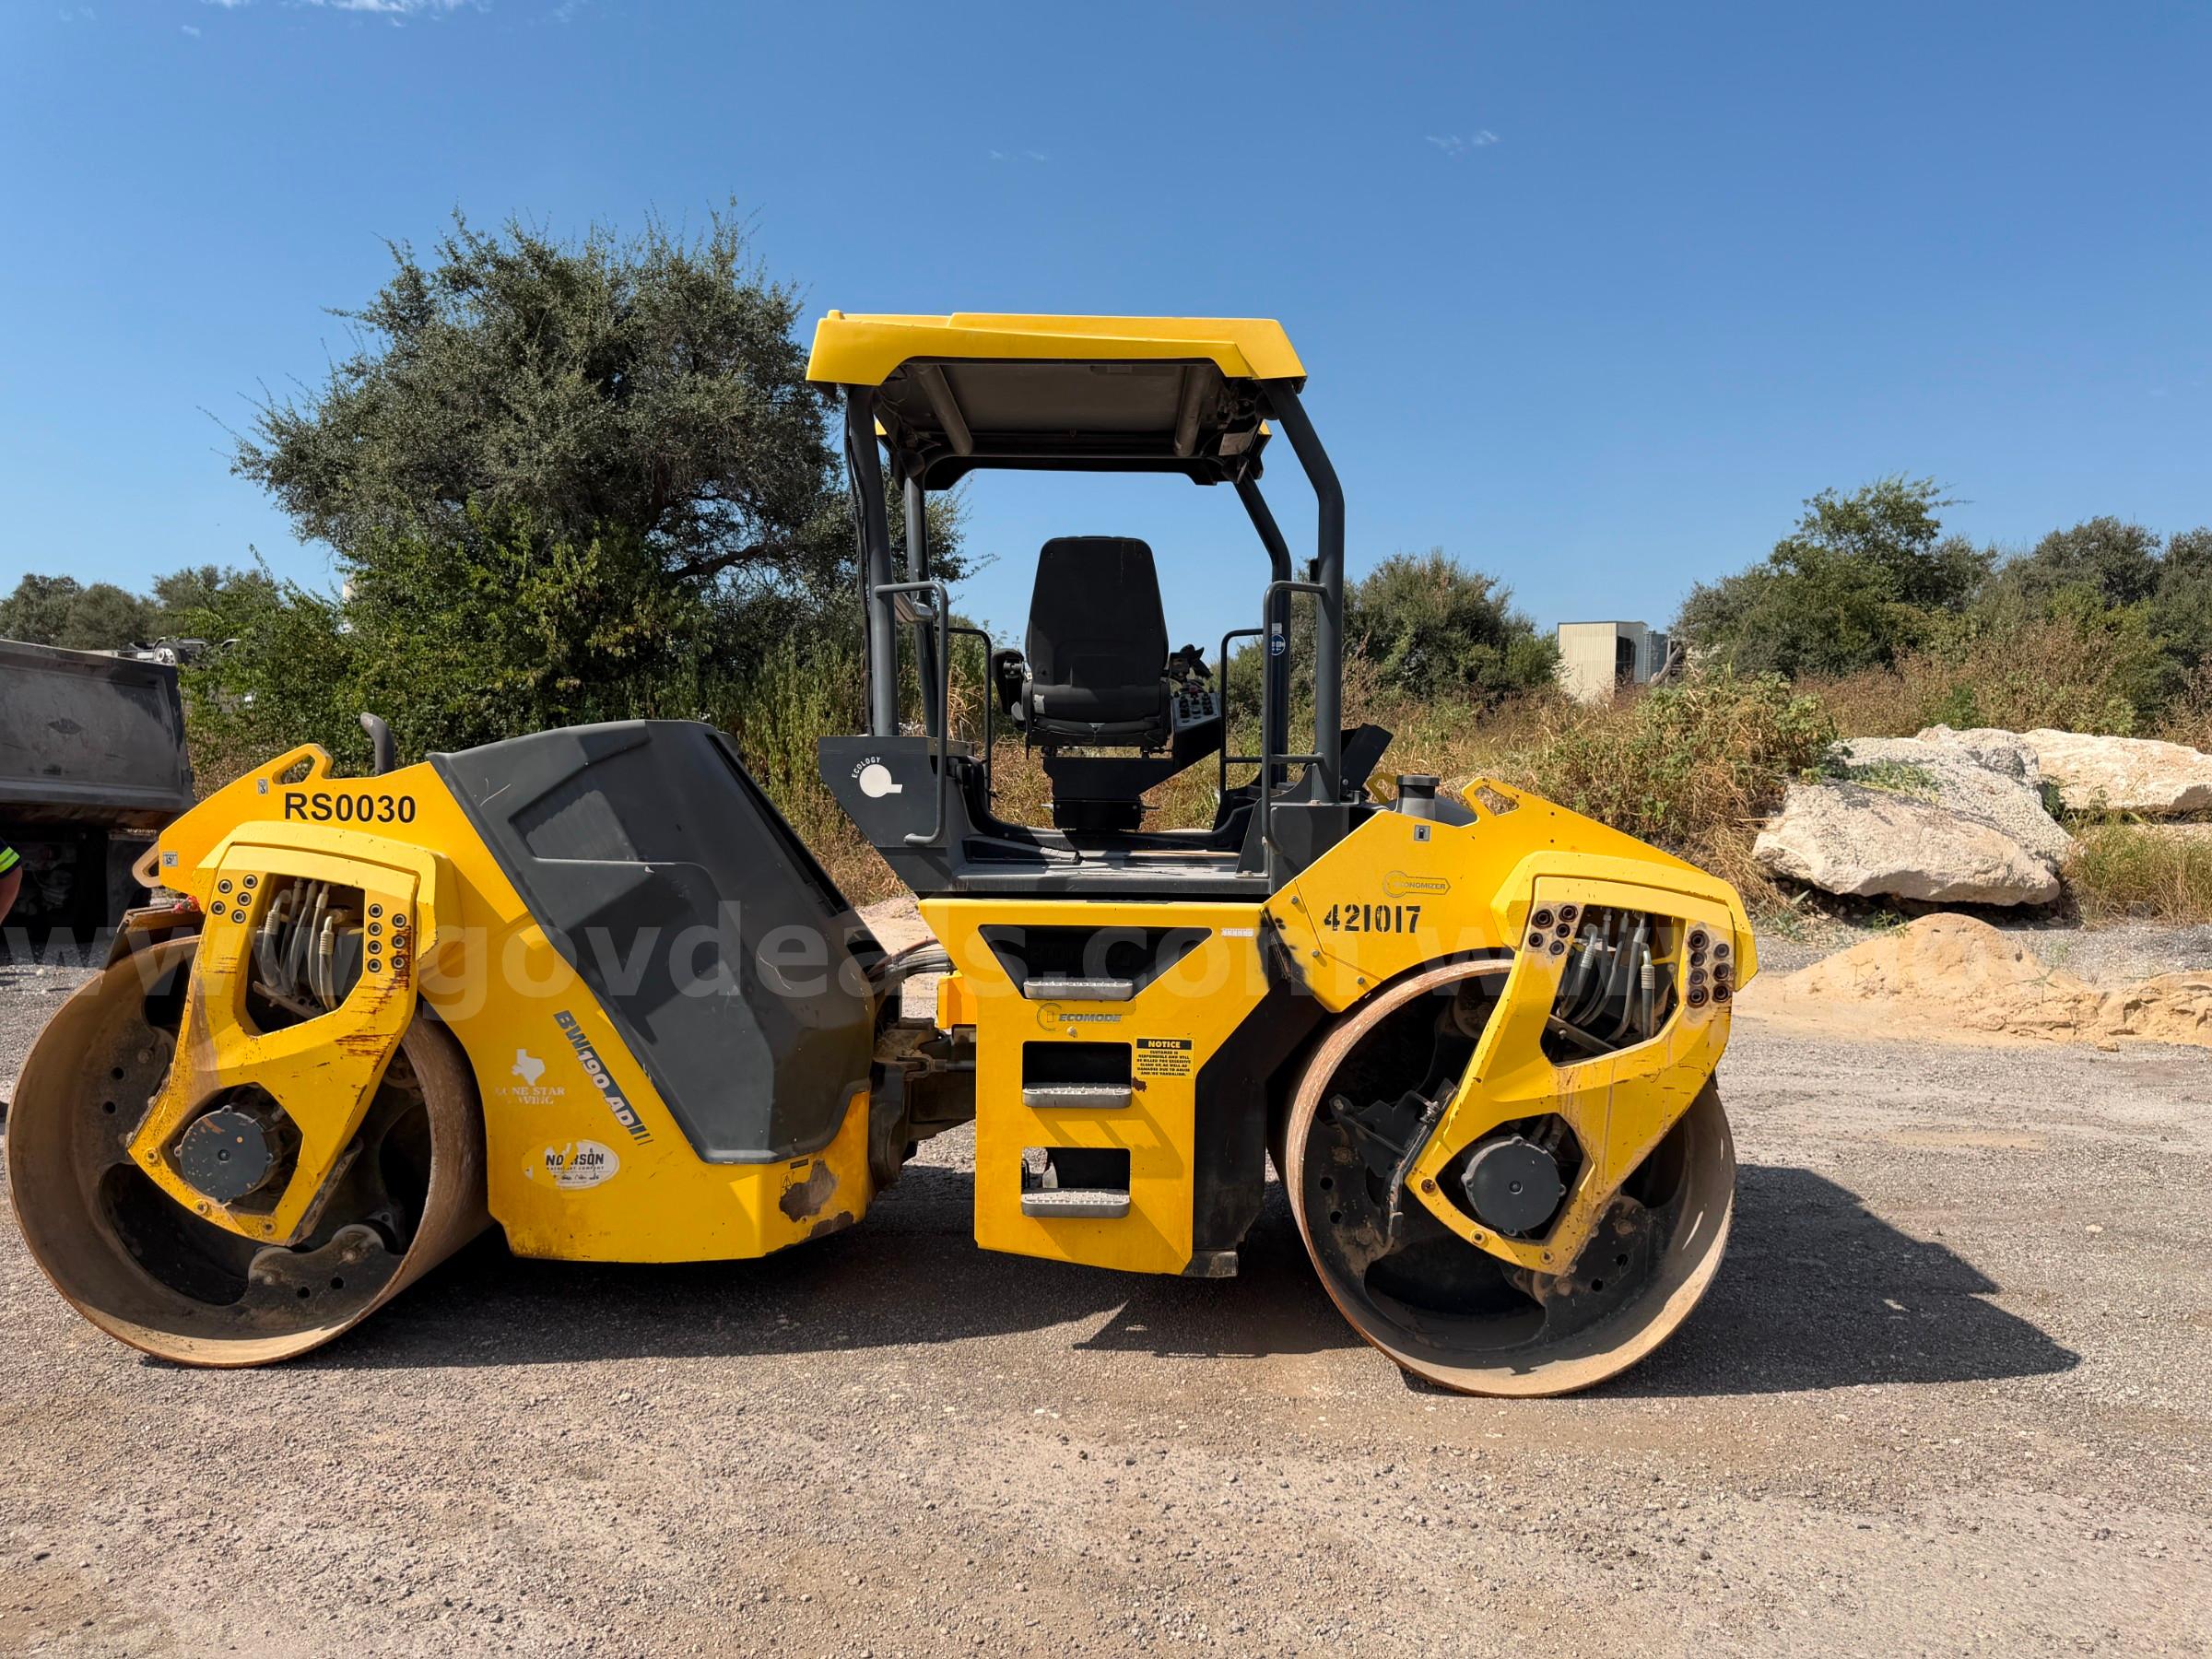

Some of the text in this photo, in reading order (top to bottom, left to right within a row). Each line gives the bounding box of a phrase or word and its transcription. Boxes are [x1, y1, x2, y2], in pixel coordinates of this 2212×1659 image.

[851, 756, 881, 779] ECOLOGY
[284, 792, 416, 824] RS0030
[1324, 903, 1421, 934] 421017
[1058, 1013, 1122, 1022] ECOMODE
[1147, 1040, 1181, 1049] NOTICE
[532, 1086, 566, 1096] STAR
